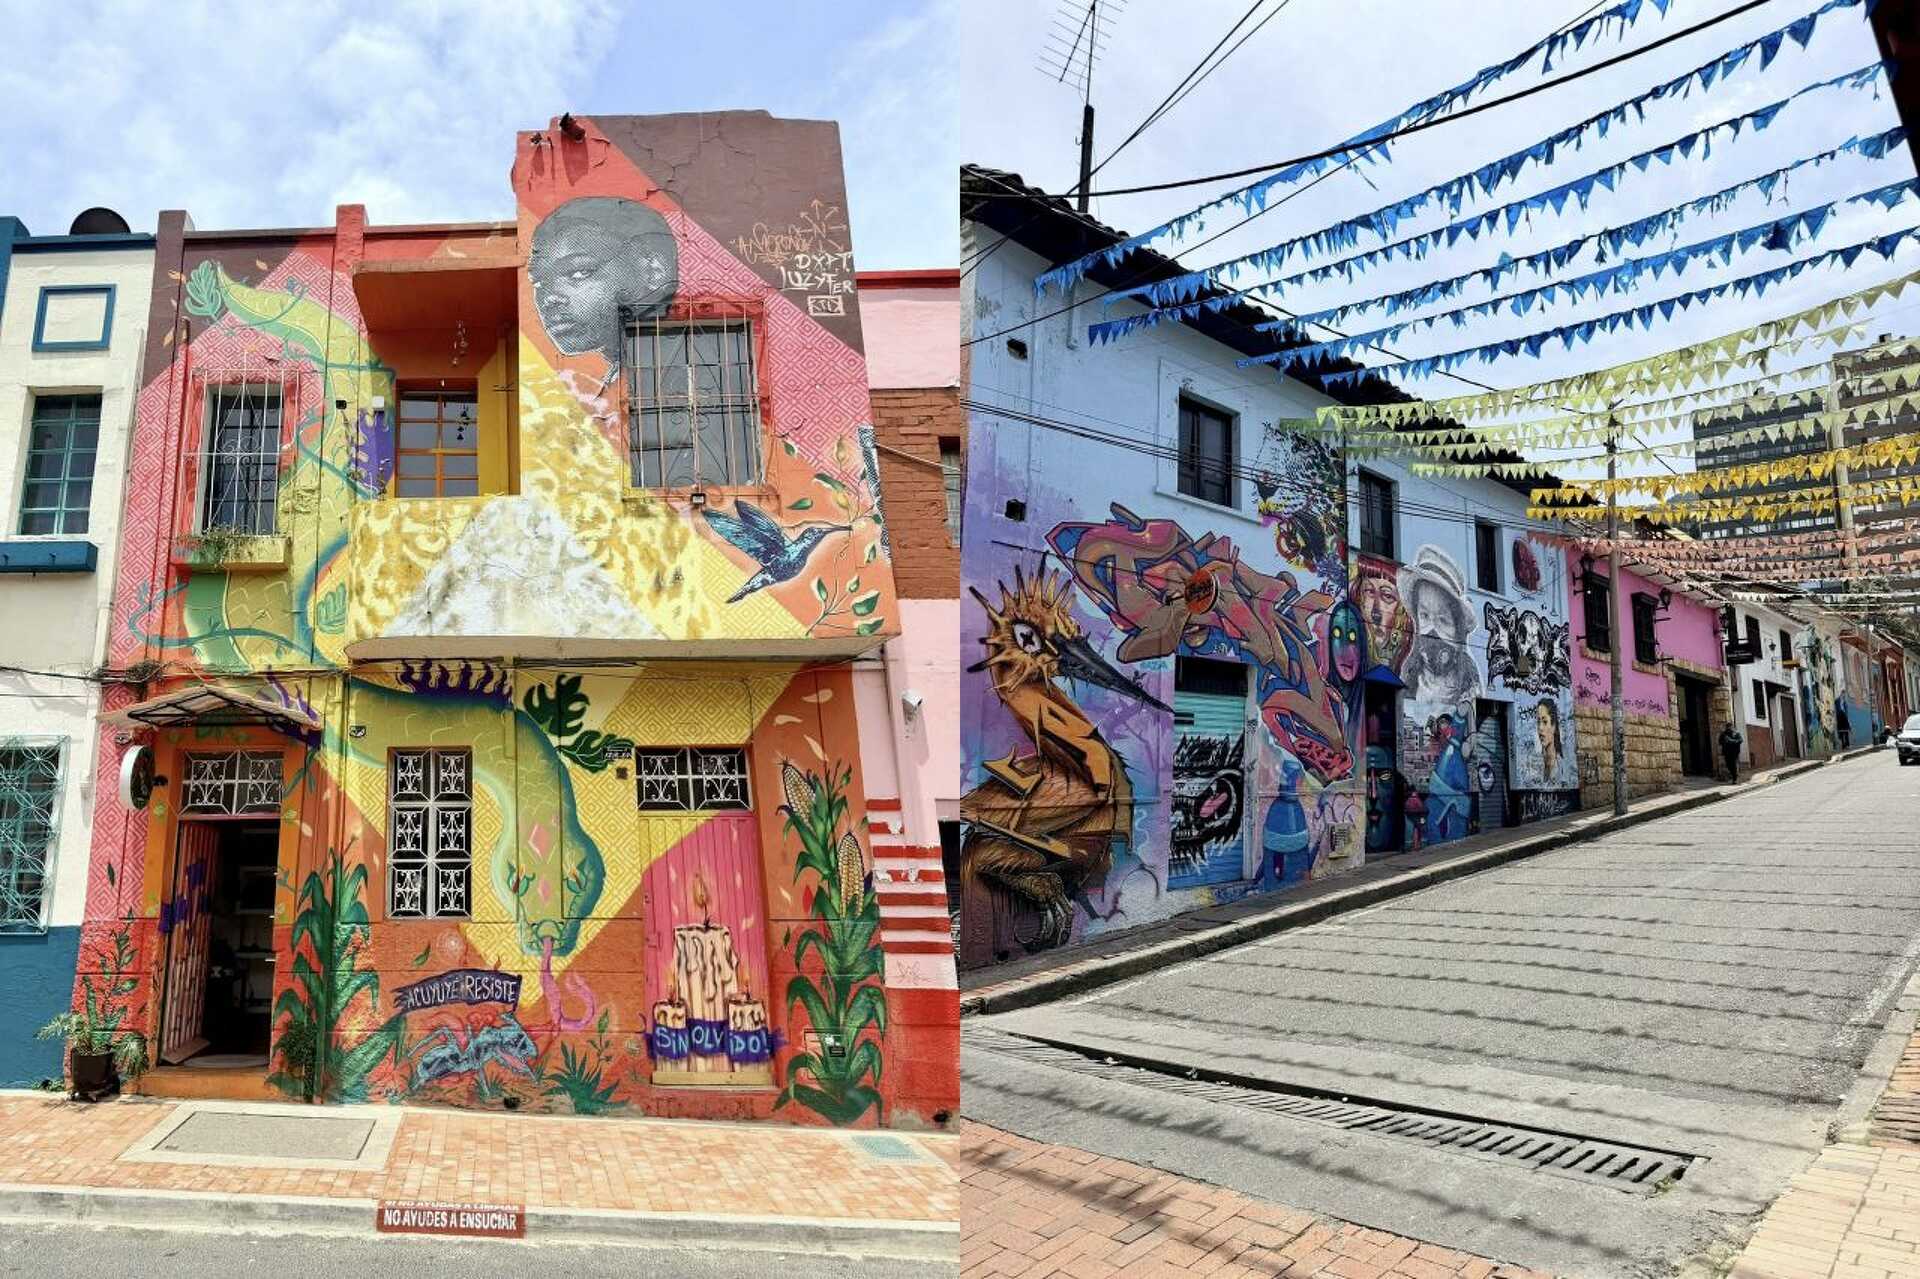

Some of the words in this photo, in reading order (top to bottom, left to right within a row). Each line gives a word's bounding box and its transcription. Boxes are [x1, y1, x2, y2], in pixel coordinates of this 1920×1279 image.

[384, 1209, 400, 1226] NO
[402, 1209, 447, 1227] AYUDES
[450, 1212, 458, 1227] A
[460, 1211, 517, 1230] ENSUCIAR
